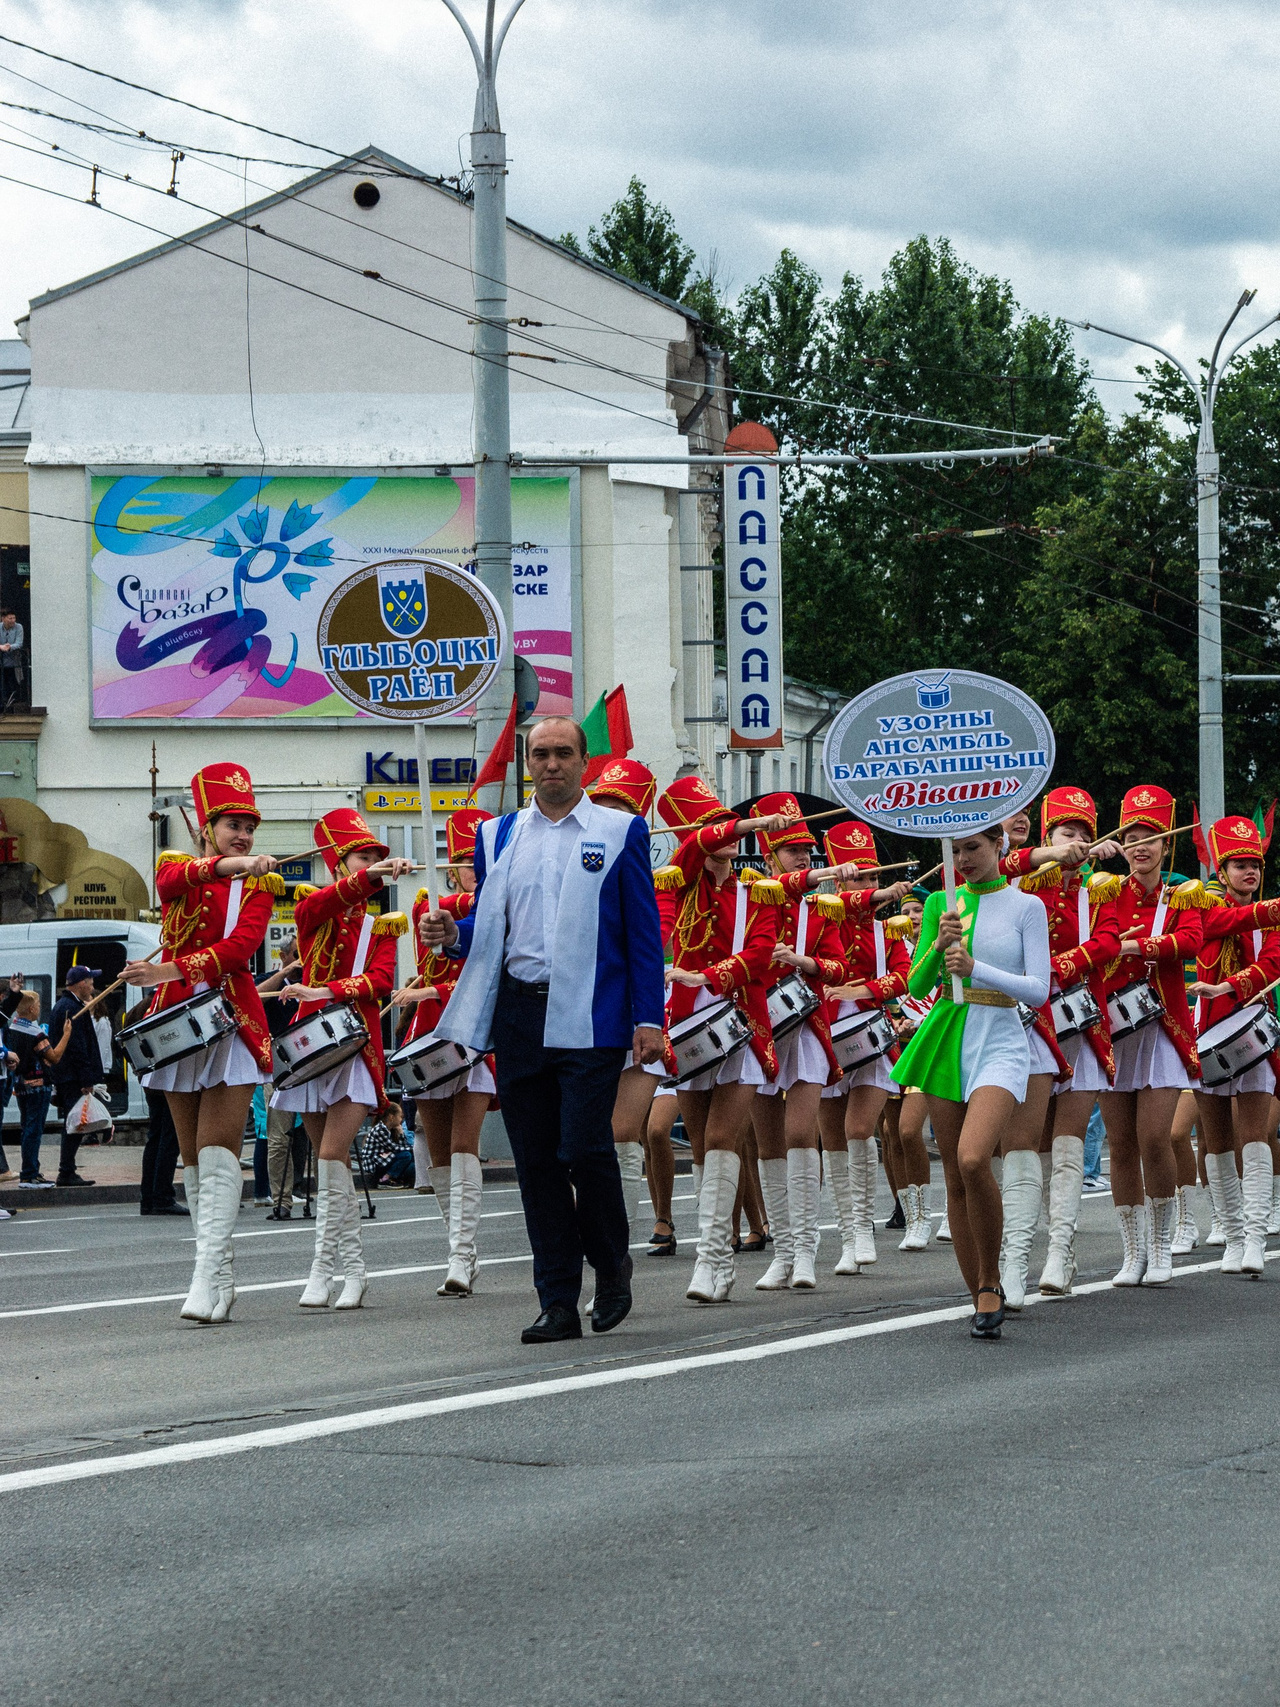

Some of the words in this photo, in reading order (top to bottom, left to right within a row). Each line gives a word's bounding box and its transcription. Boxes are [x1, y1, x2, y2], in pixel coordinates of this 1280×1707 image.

[384, 546, 460, 555] Международный
[513, 564, 548, 577] ЗАР
[140, 586, 229, 623] Базар
[165, 627, 204, 648] віцебску
[513, 639, 538, 649] V.BY
[322, 637, 499, 671] ГЛЫБОЦКІ
[368, 667, 457, 701] РАЁН
[538, 676, 557, 686] азар
[878, 710, 994, 734] УЗОРНЫ
[864, 732, 1012, 757] АНСАМБЛЬ
[833, 751, 1048, 781] БАРАБАНШЧЫЦ
[394, 797, 424, 807] PS
[863, 777, 1022, 813] «Віват»
[897, 817, 908, 827] г.
[913, 811, 990, 827] Глыбокае
[280, 865, 304, 876] LUB
[84, 883, 107, 893] КЛУБ
[74, 895, 117, 906] РЕСТОРАН
